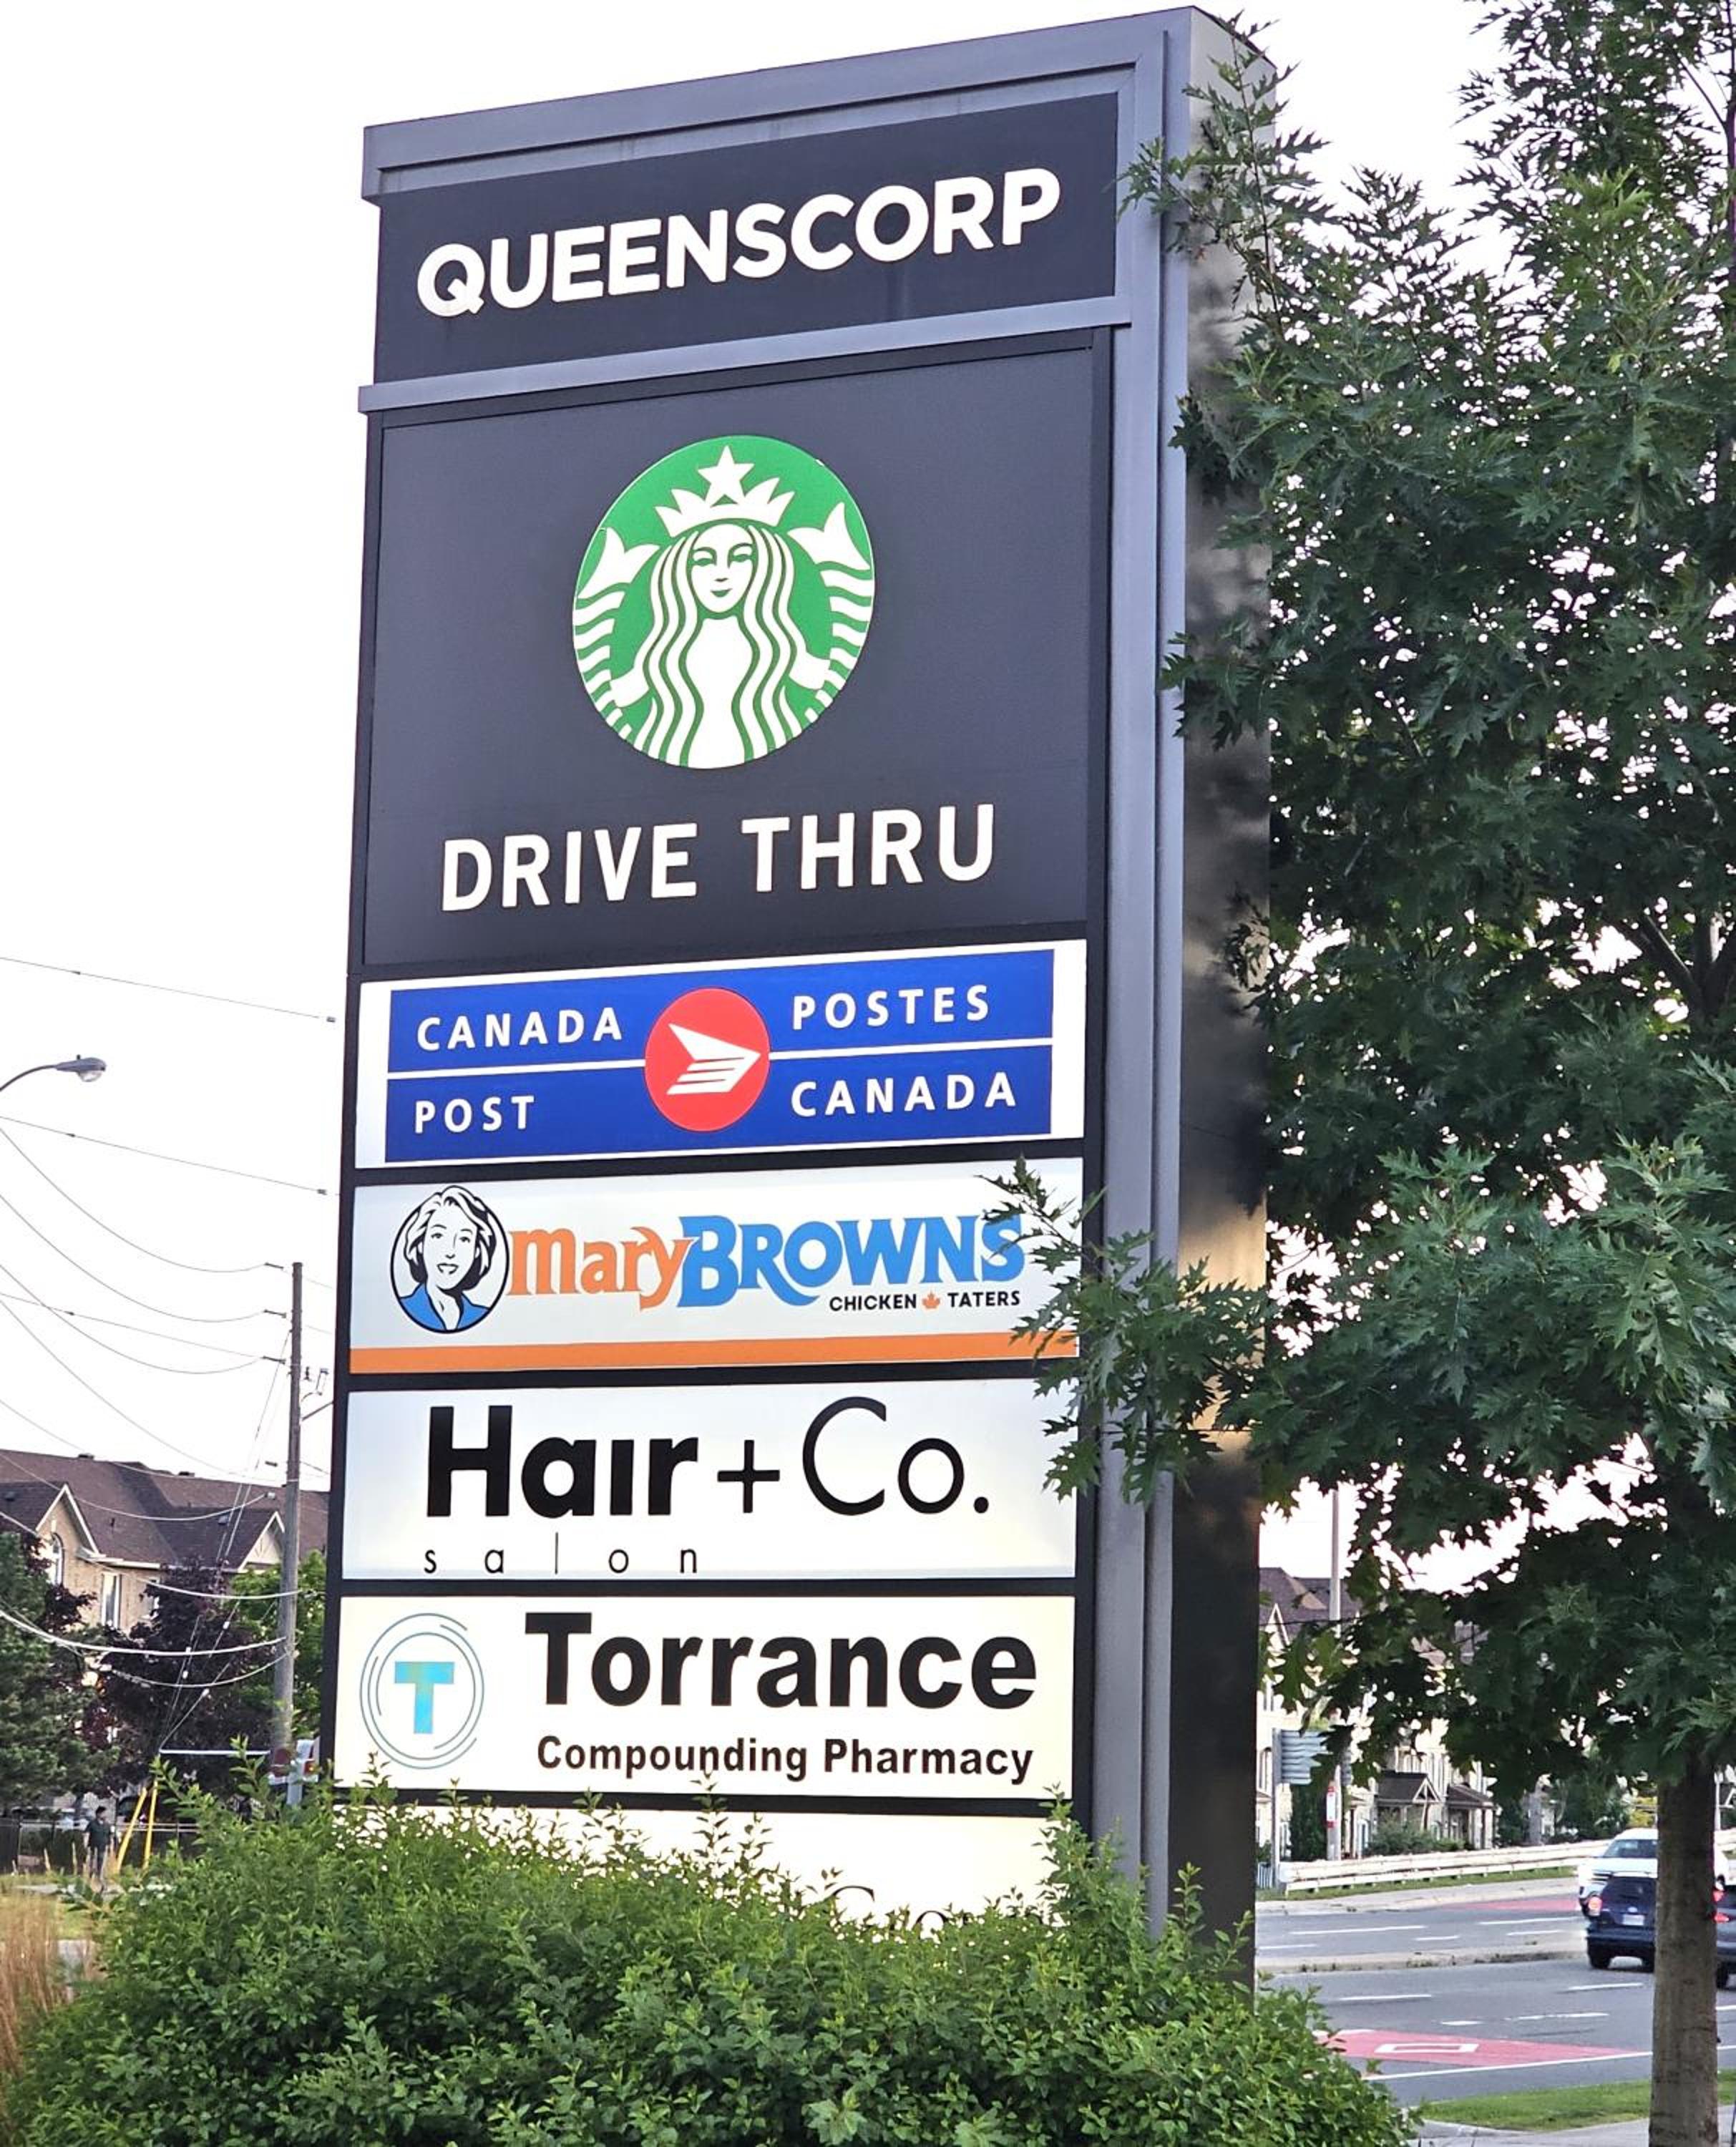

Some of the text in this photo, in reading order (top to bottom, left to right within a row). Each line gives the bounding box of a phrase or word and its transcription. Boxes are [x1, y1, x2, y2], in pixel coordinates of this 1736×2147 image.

[417, 167, 1060, 317] QUEENSCORP
[442, 804, 994, 911] DRIVE THRU
[417, 1007, 622, 1051] CANADA
[793, 984, 988, 1030] POSTES
[415, 1095, 535, 1134] POST
[791, 1072, 1015, 1117] CANADA
[829, 1290, 1020, 1312] CHICKEN TATERS
[525, 1612, 1036, 1710] Torrance
[537, 1735, 1033, 1785] Compounding Pharmacy
